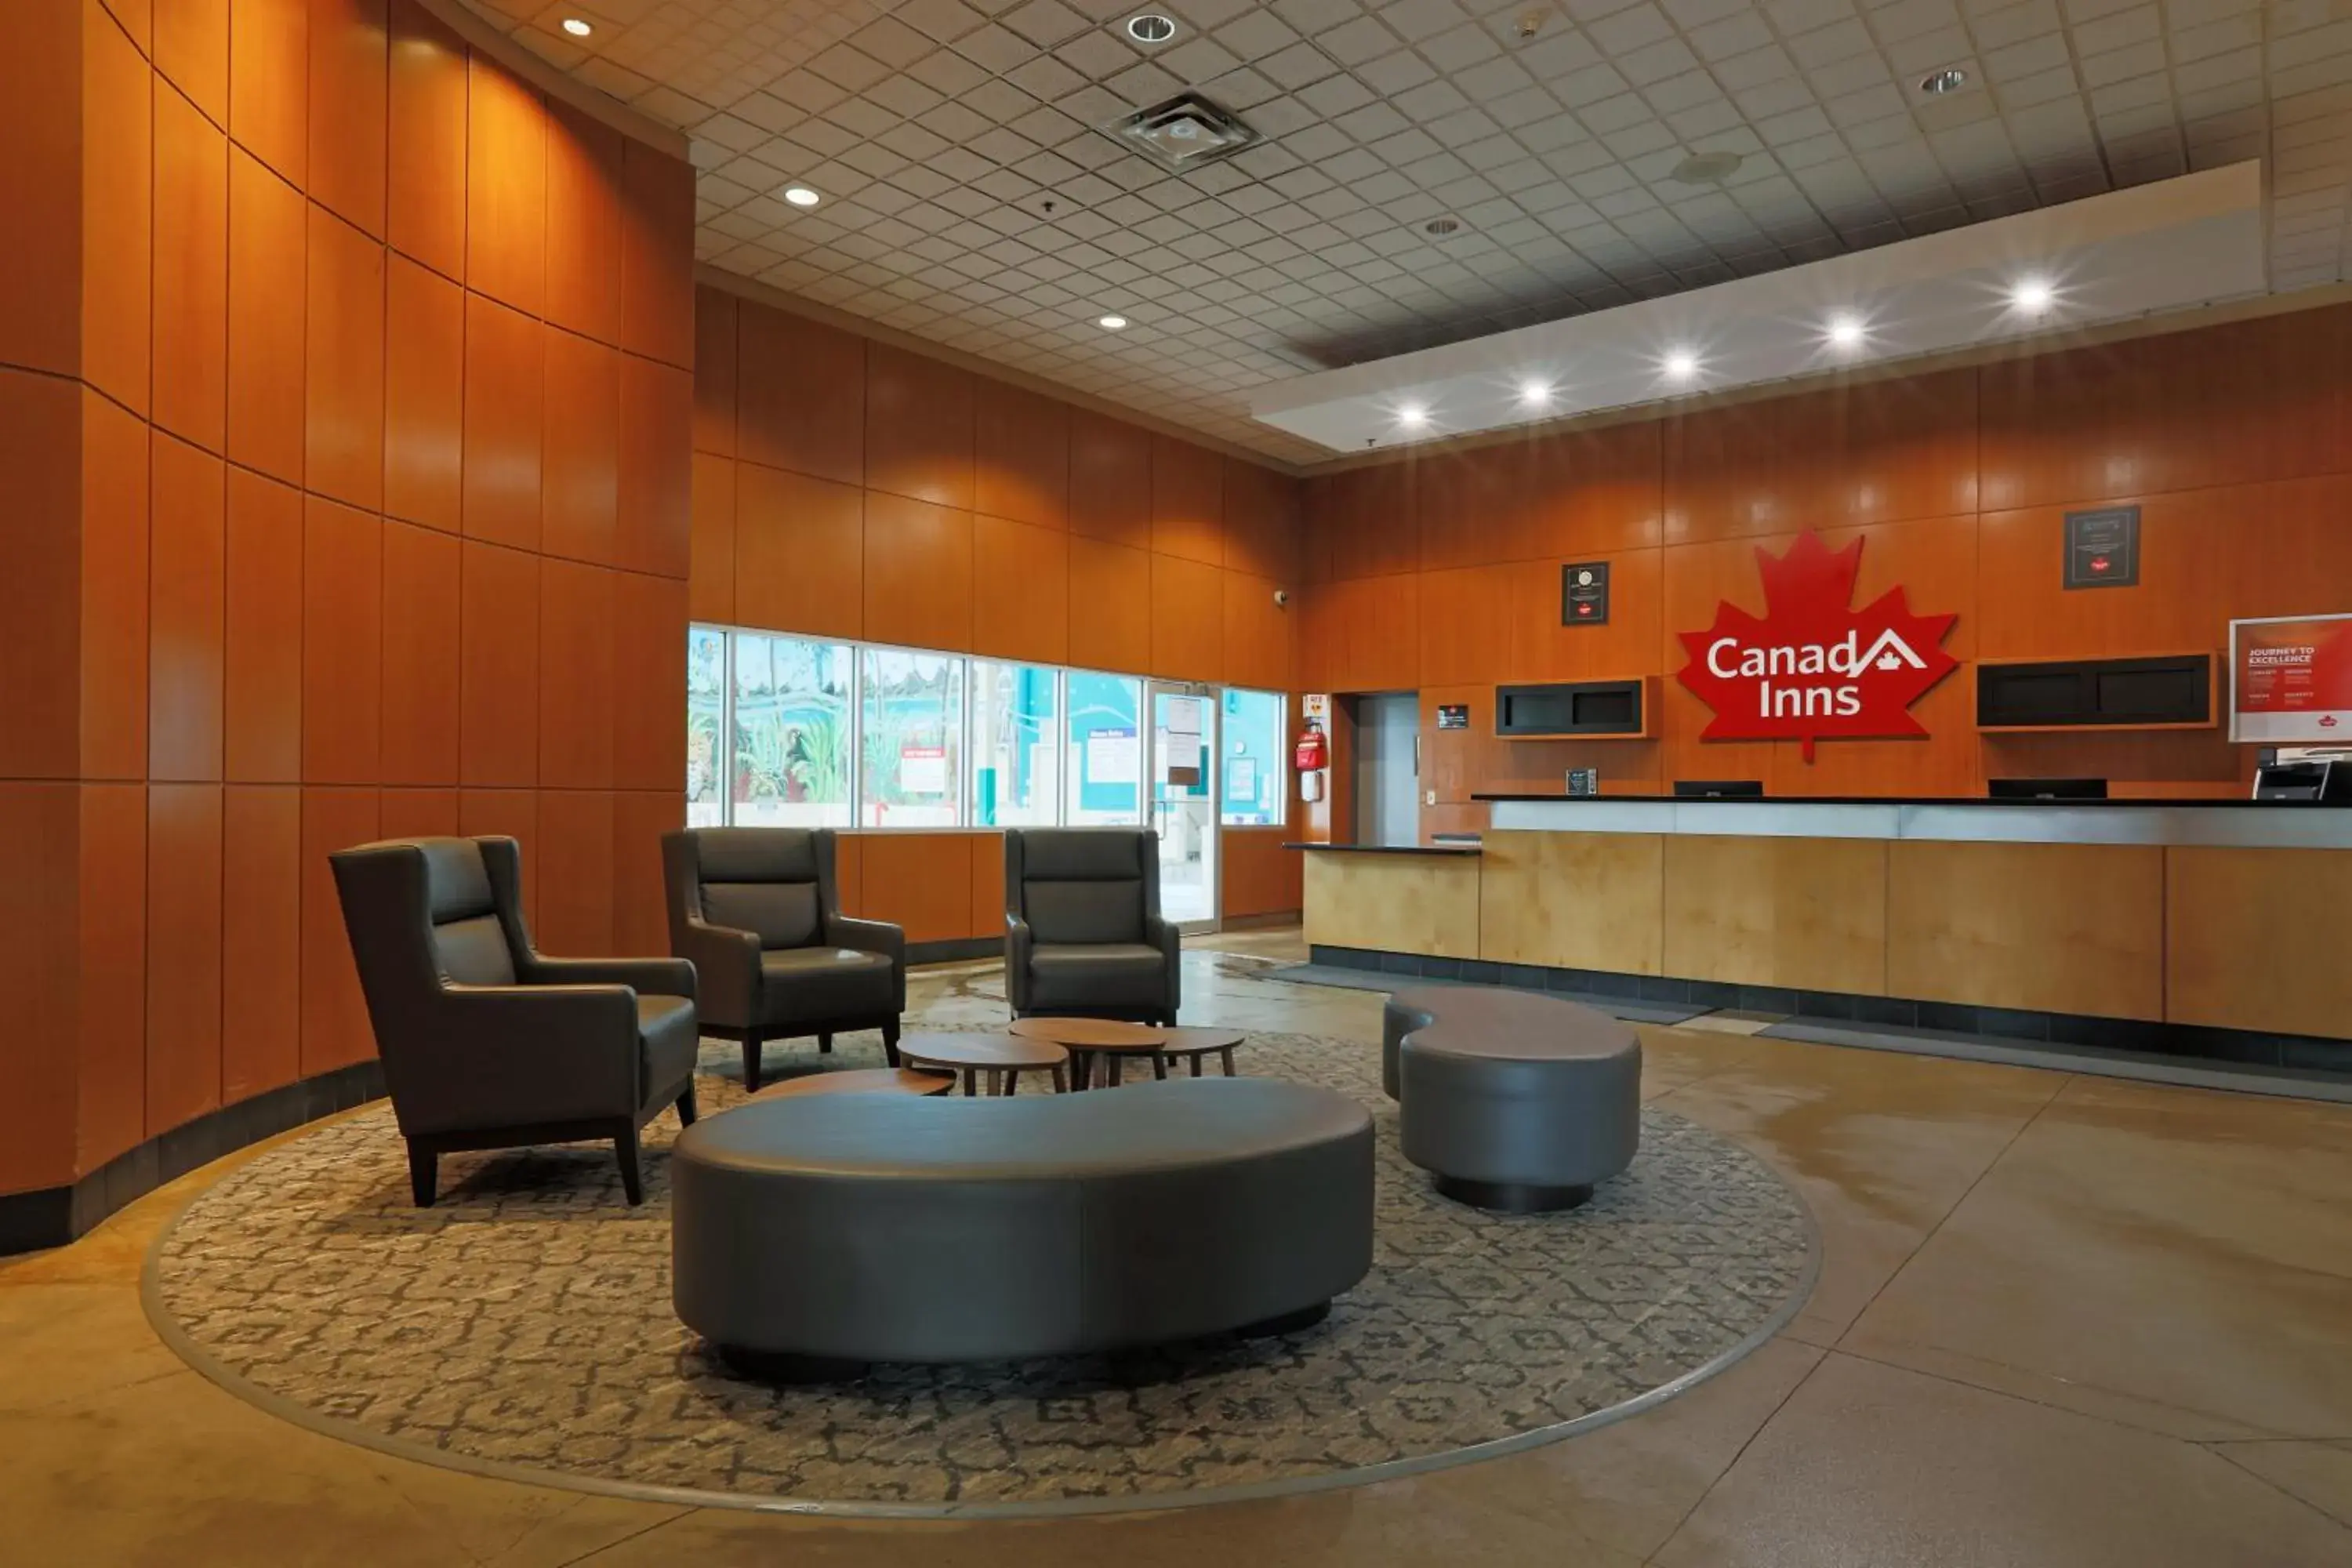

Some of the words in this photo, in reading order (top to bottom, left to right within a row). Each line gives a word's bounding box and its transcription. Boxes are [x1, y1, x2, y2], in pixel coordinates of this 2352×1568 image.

[2249, 648, 2296, 656] JOURNEY
[2249, 655, 2311, 664] EXCELLENCE
[1760, 680, 1860, 717] Inns
